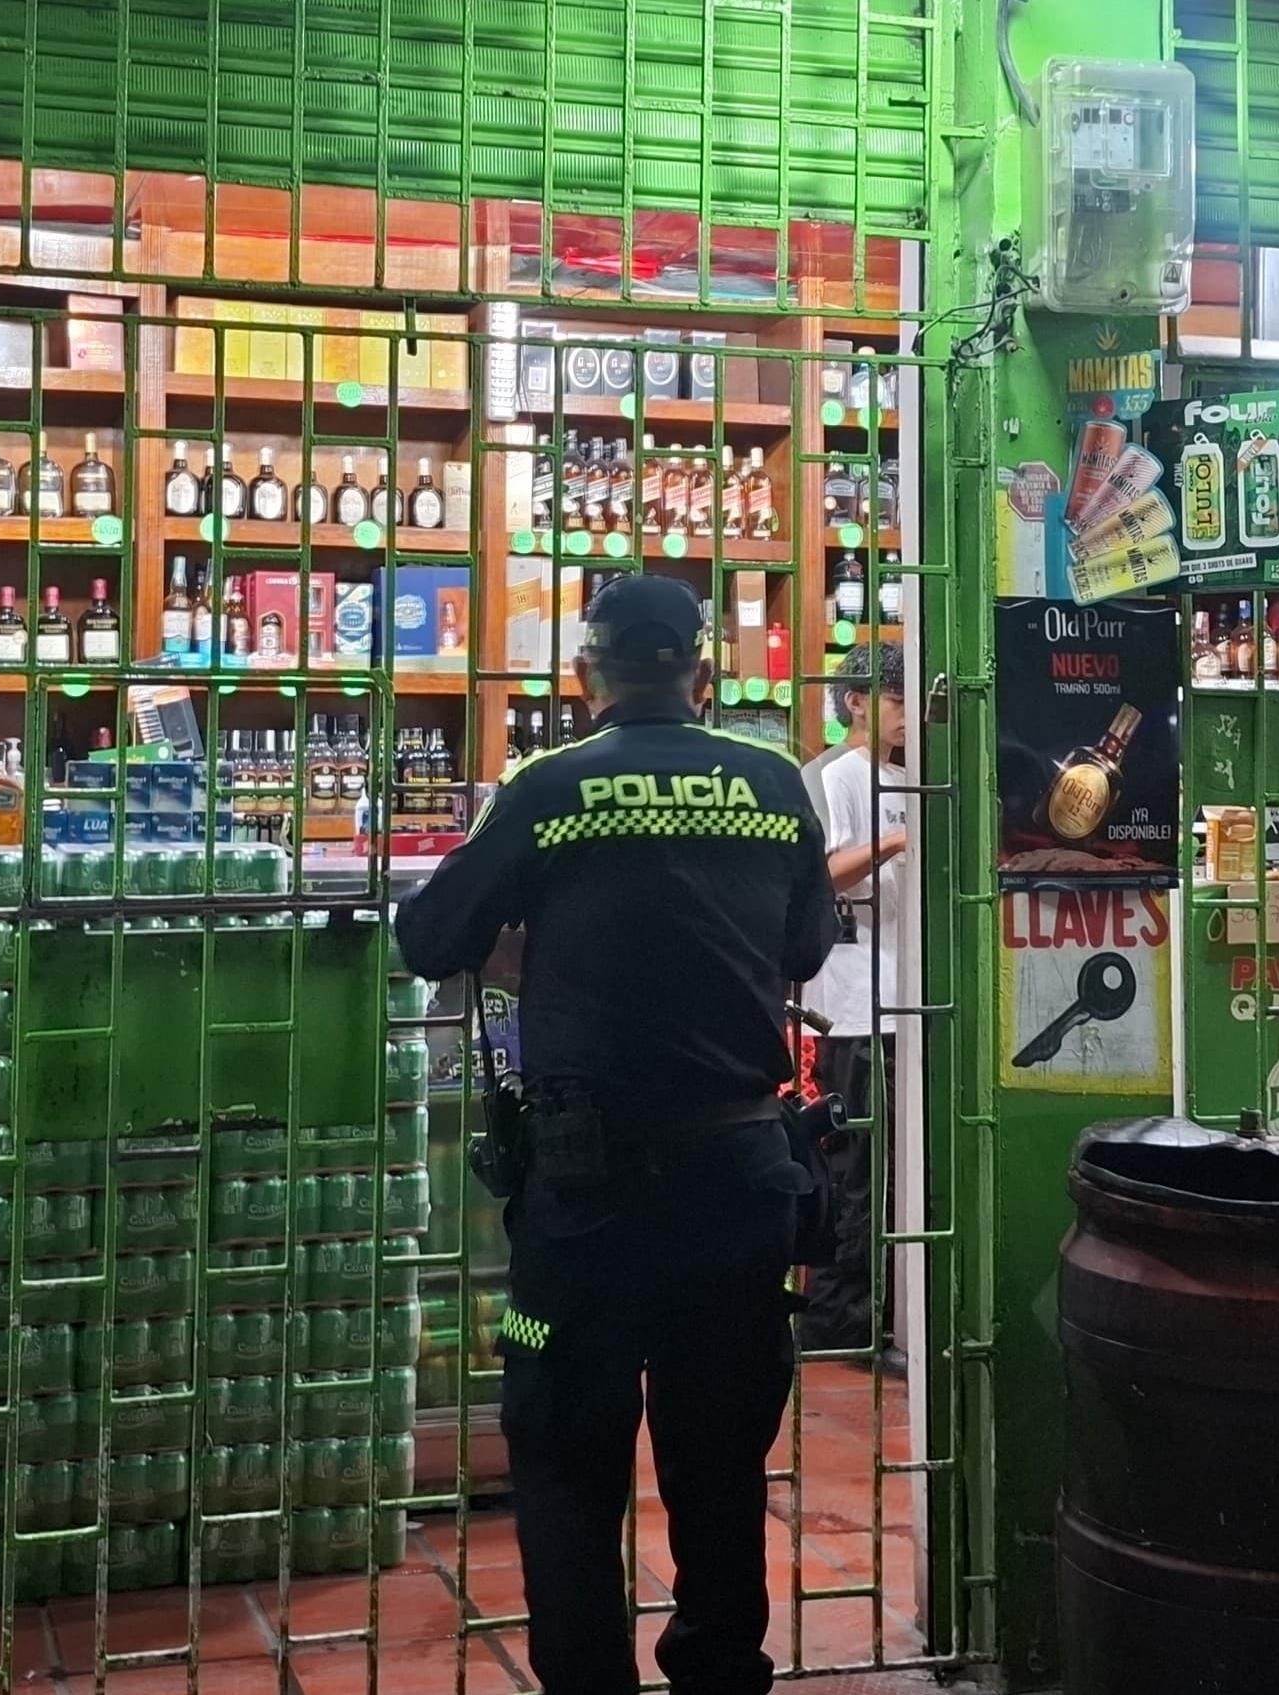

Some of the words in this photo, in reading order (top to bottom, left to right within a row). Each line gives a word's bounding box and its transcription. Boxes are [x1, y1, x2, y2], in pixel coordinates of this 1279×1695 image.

[1069, 353, 1152, 393] MAMITAS
[1196, 461, 1211, 526] LULO
[1208, 559, 1225, 569] SHOTS
[1045, 606, 1080, 643] Old
[1084, 607, 1125, 642] Parr
[1051, 652, 1119, 679] NUEVO
[1054, 680, 1091, 695] TAMAÑO
[1093, 682, 1121, 696] 500ml
[580, 764, 759, 810] POLICÍA
[83, 818, 108, 831] LUA
[1131, 806, 1149, 825] ¡YA
[1108, 823, 1172, 841] DISPONIBLE!
[214, 878, 259, 889] Costeña
[1003, 889, 1169, 949] LLAVES
